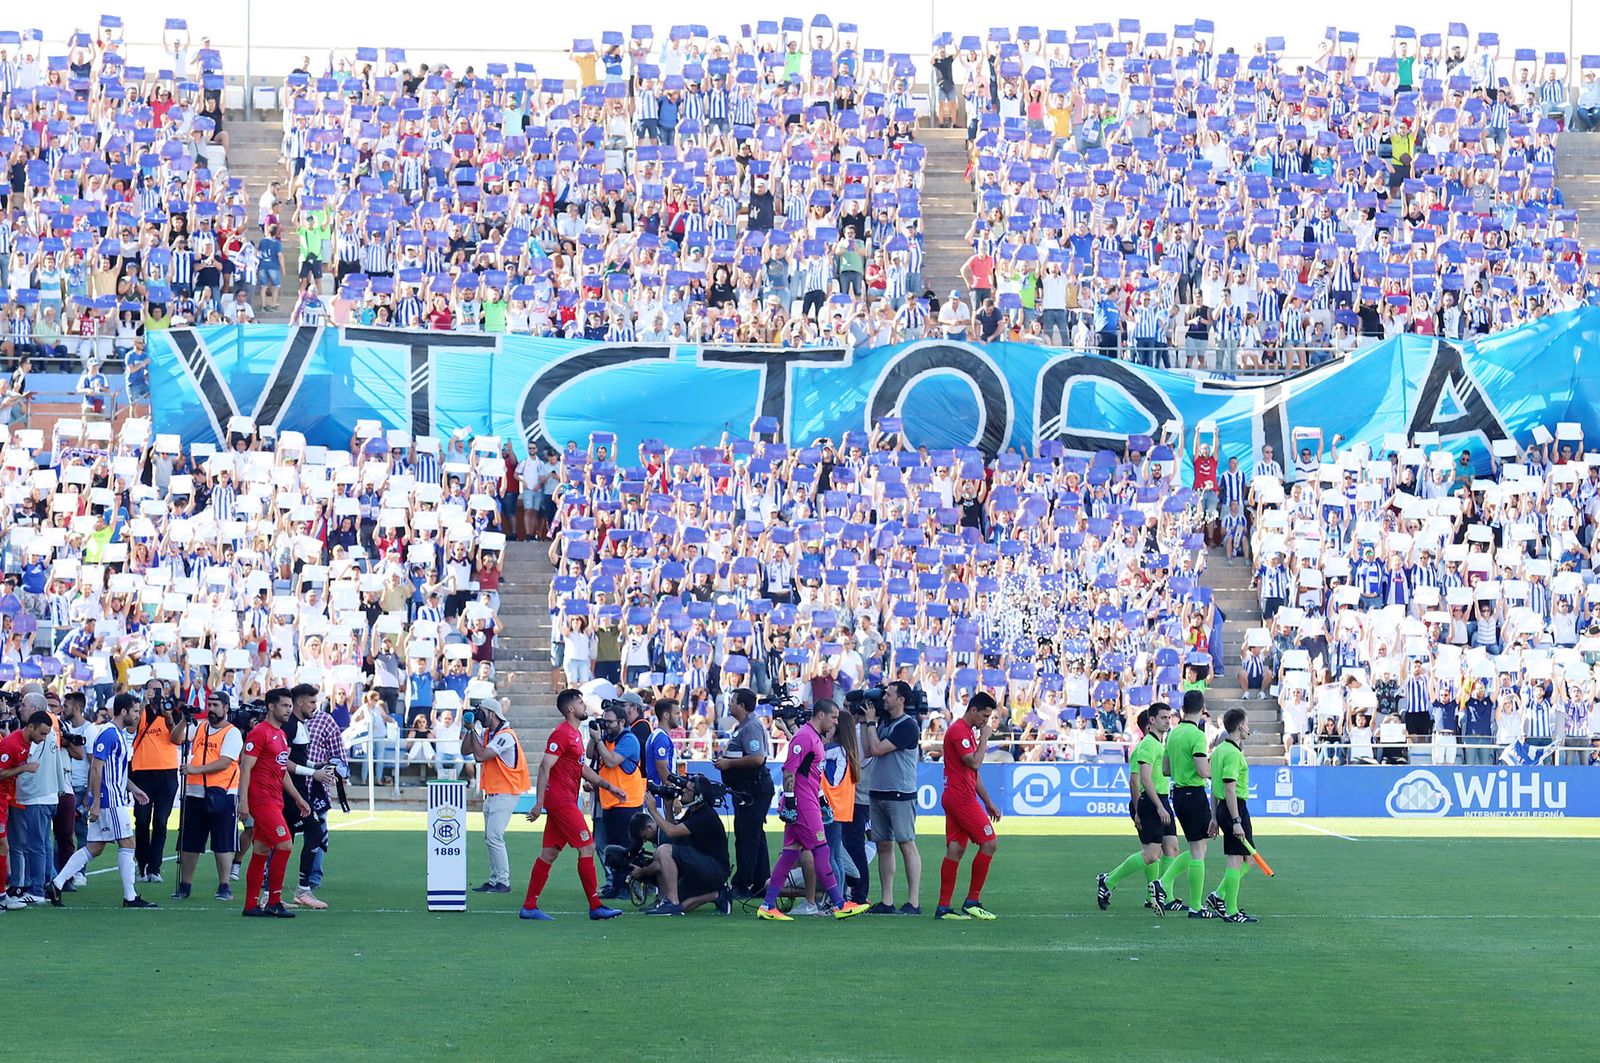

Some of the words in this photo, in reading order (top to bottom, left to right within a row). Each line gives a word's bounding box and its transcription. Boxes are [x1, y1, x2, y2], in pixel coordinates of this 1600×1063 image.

[167, 325, 1520, 474] VICTORIA
[1453, 769, 1567, 809] WiHu
[434, 847, 461, 856] 1889
